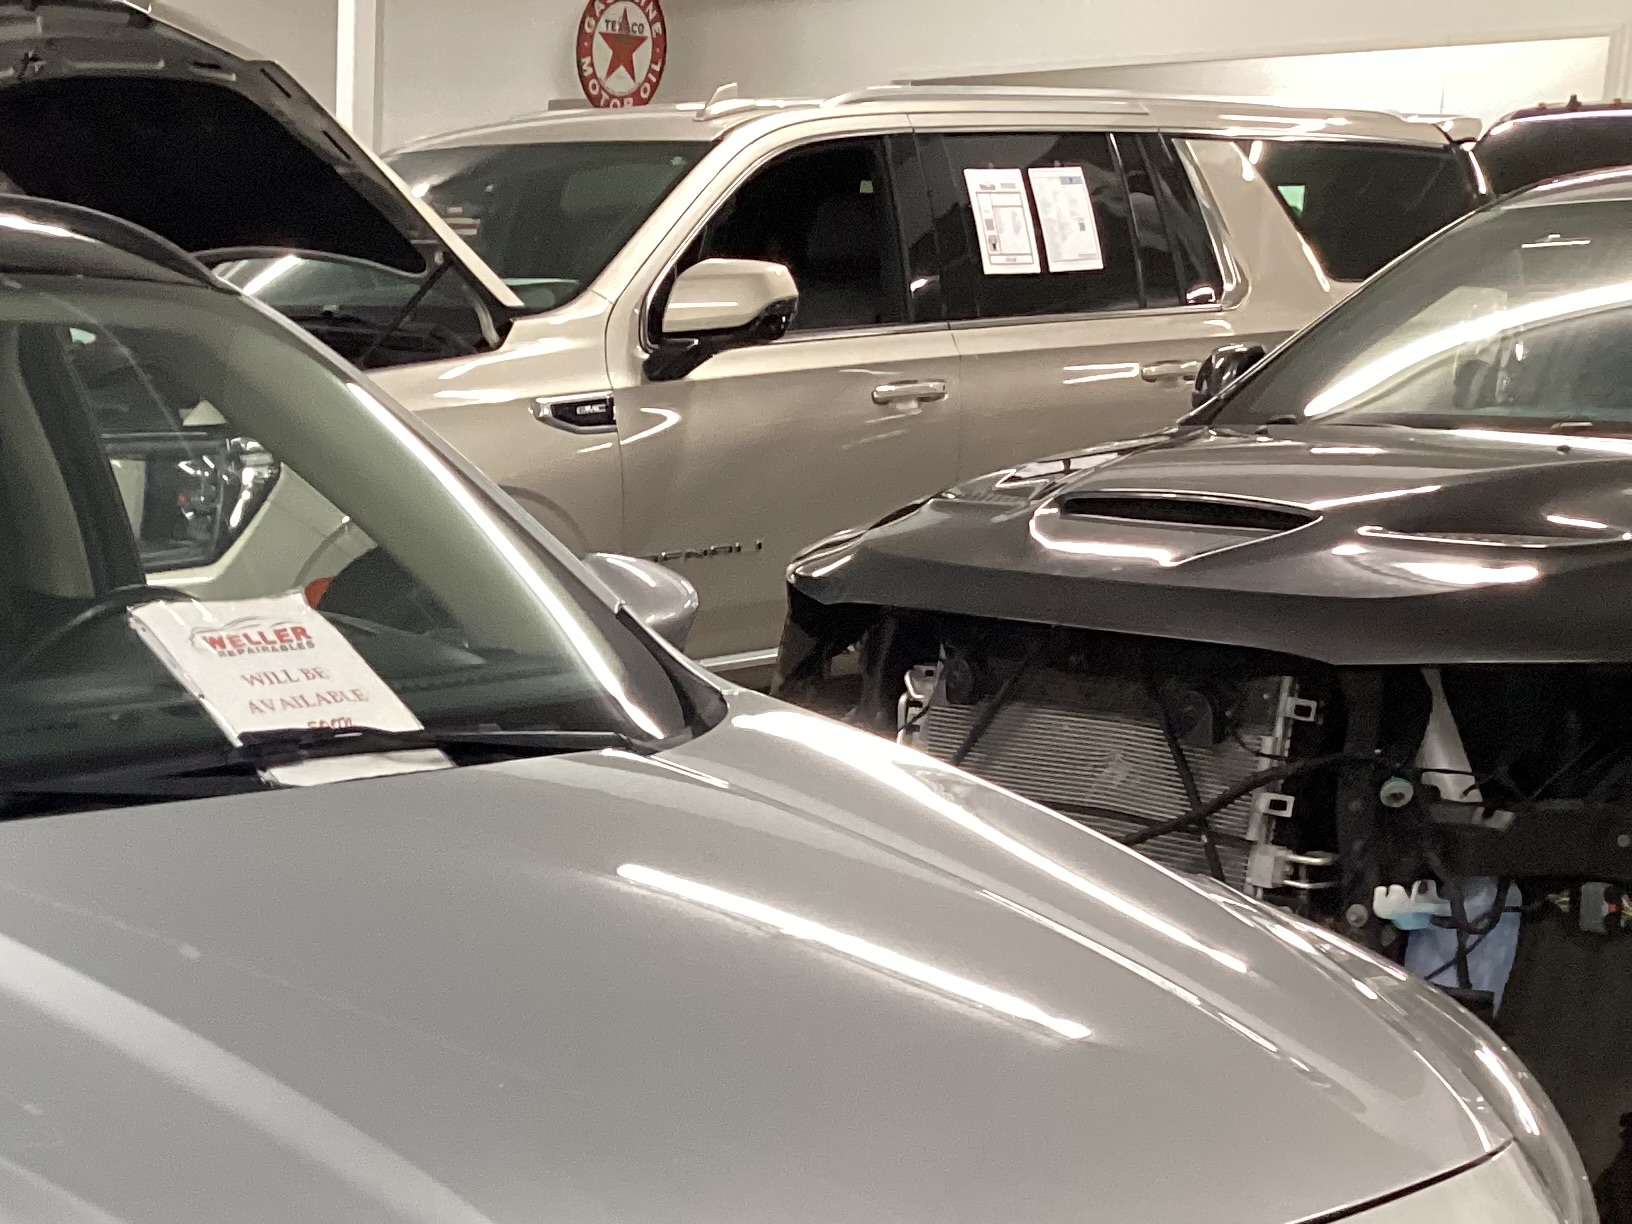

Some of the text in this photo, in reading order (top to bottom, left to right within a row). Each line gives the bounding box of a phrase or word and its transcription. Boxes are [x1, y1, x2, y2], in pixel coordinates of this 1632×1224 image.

[640, 59, 662, 99] OIL
[201, 626, 312, 651] WELLER
[217, 640, 315, 657] REPAIRABLES
[240, 666, 330, 686] WILL BE
[248, 688, 369, 714] AVAILABLE
